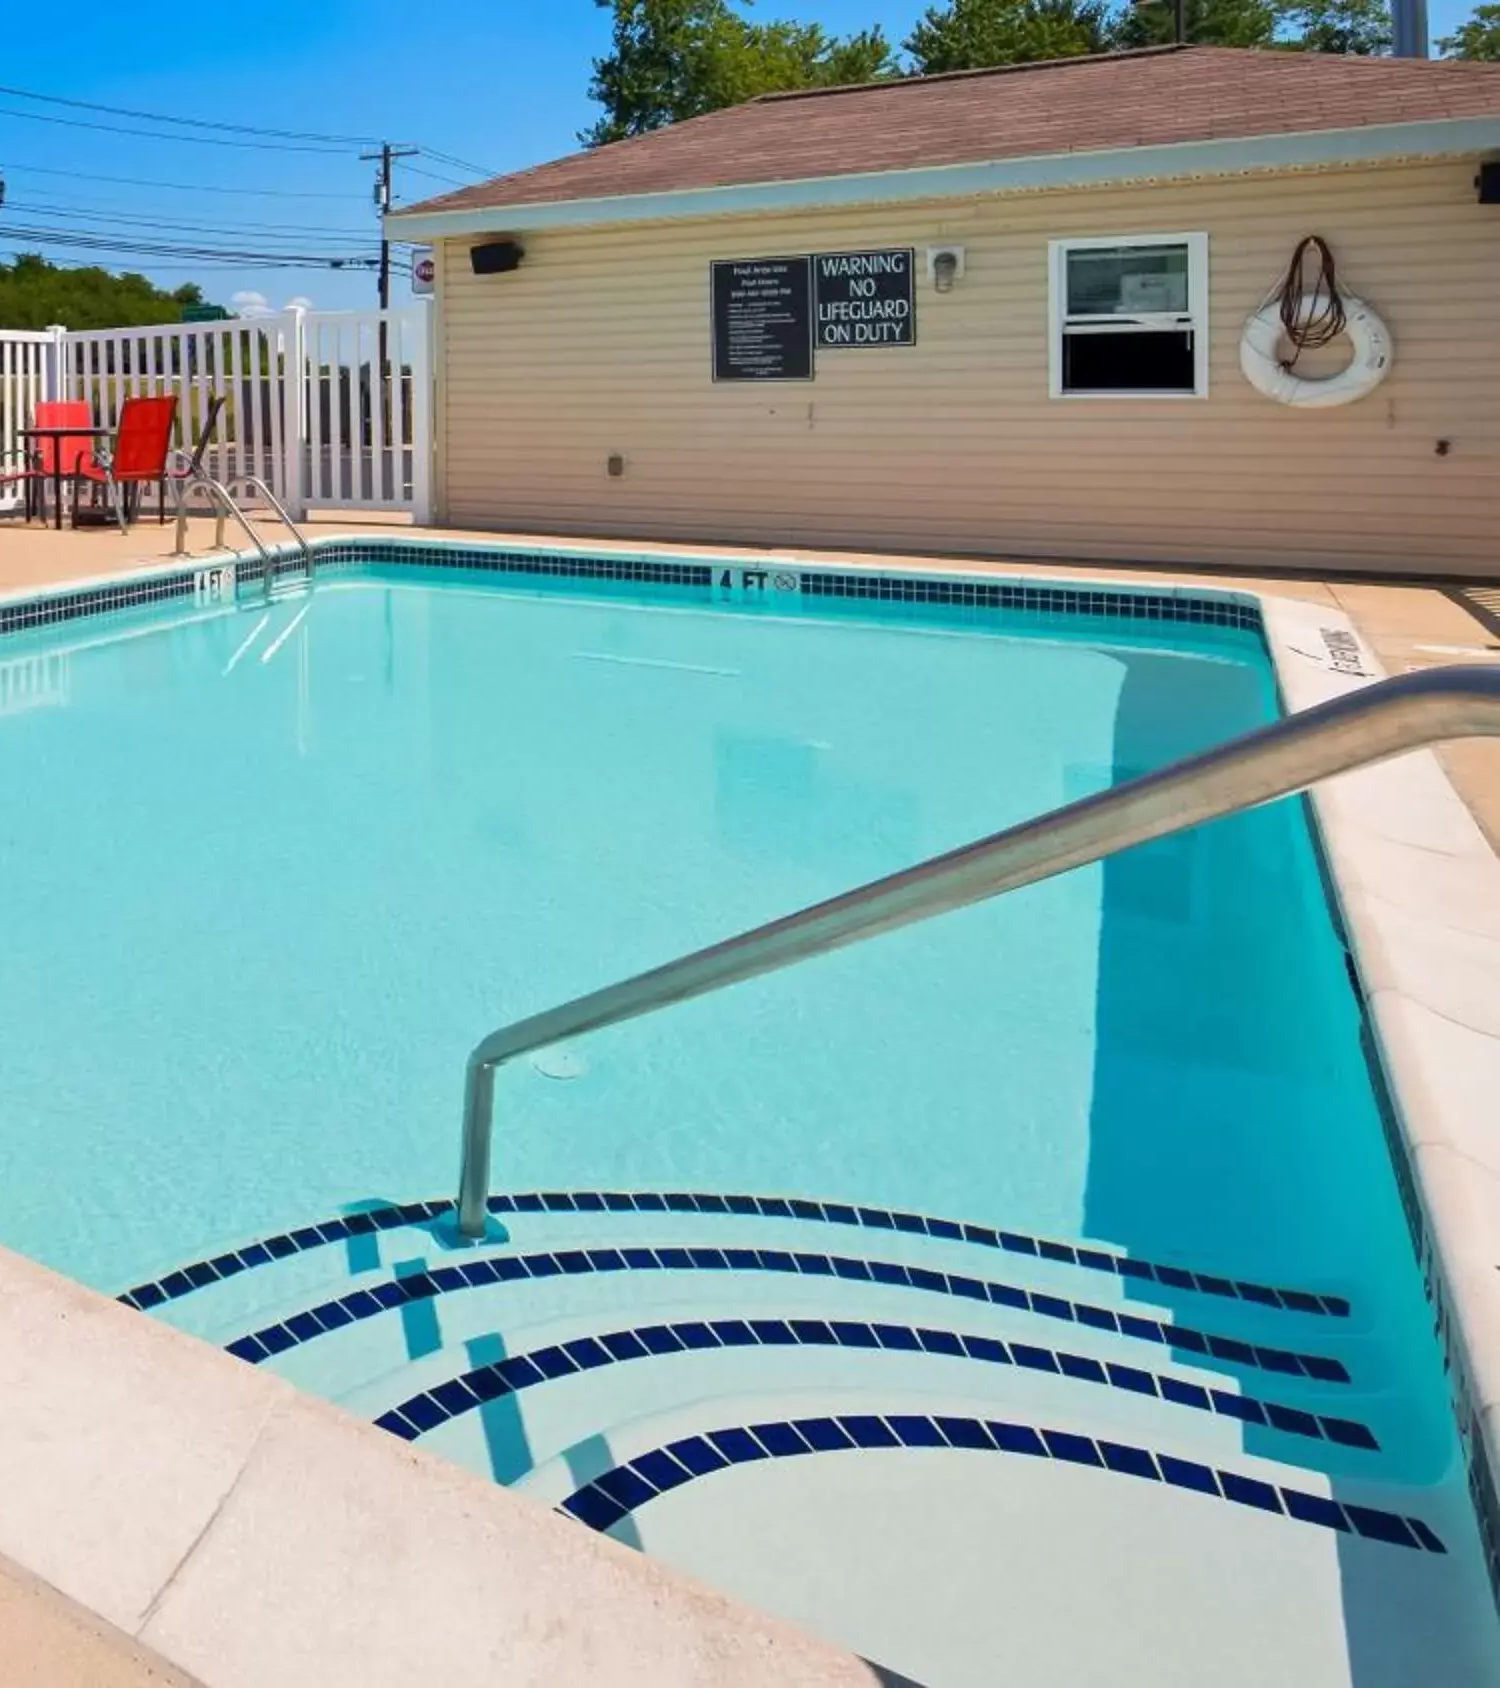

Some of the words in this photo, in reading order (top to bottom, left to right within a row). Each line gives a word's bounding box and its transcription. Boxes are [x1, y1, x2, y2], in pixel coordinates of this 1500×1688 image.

[821, 254, 904, 276] WARNING
[849, 278, 876, 297] NO
[819, 299, 908, 321] LIFEGUARD
[824, 324, 850, 343] ON
[855, 322, 903, 342] DUTY
[719, 569, 732, 589] 4
[742, 571, 768, 590] FT
